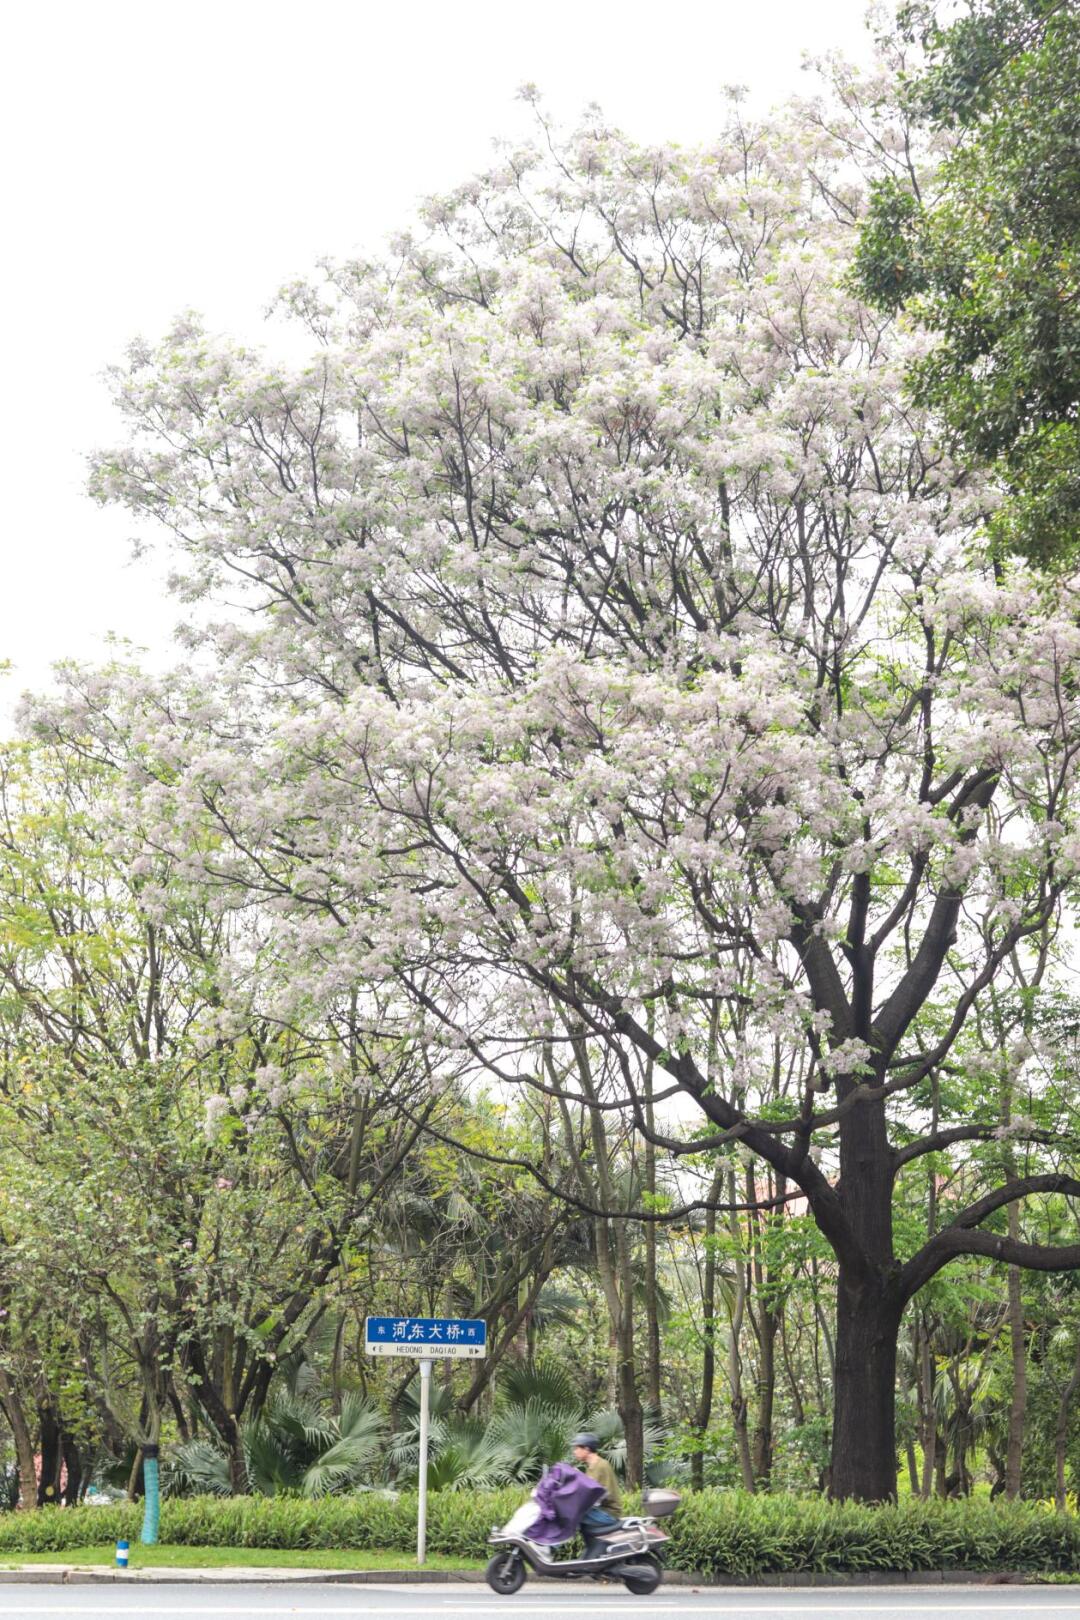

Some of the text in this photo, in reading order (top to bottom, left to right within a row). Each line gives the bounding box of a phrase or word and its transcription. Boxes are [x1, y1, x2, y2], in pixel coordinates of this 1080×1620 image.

[377, 1322, 476, 1340] 东 河东大桥 西
[378, 1345, 474, 1355] E HEDONG DAQIAO W
